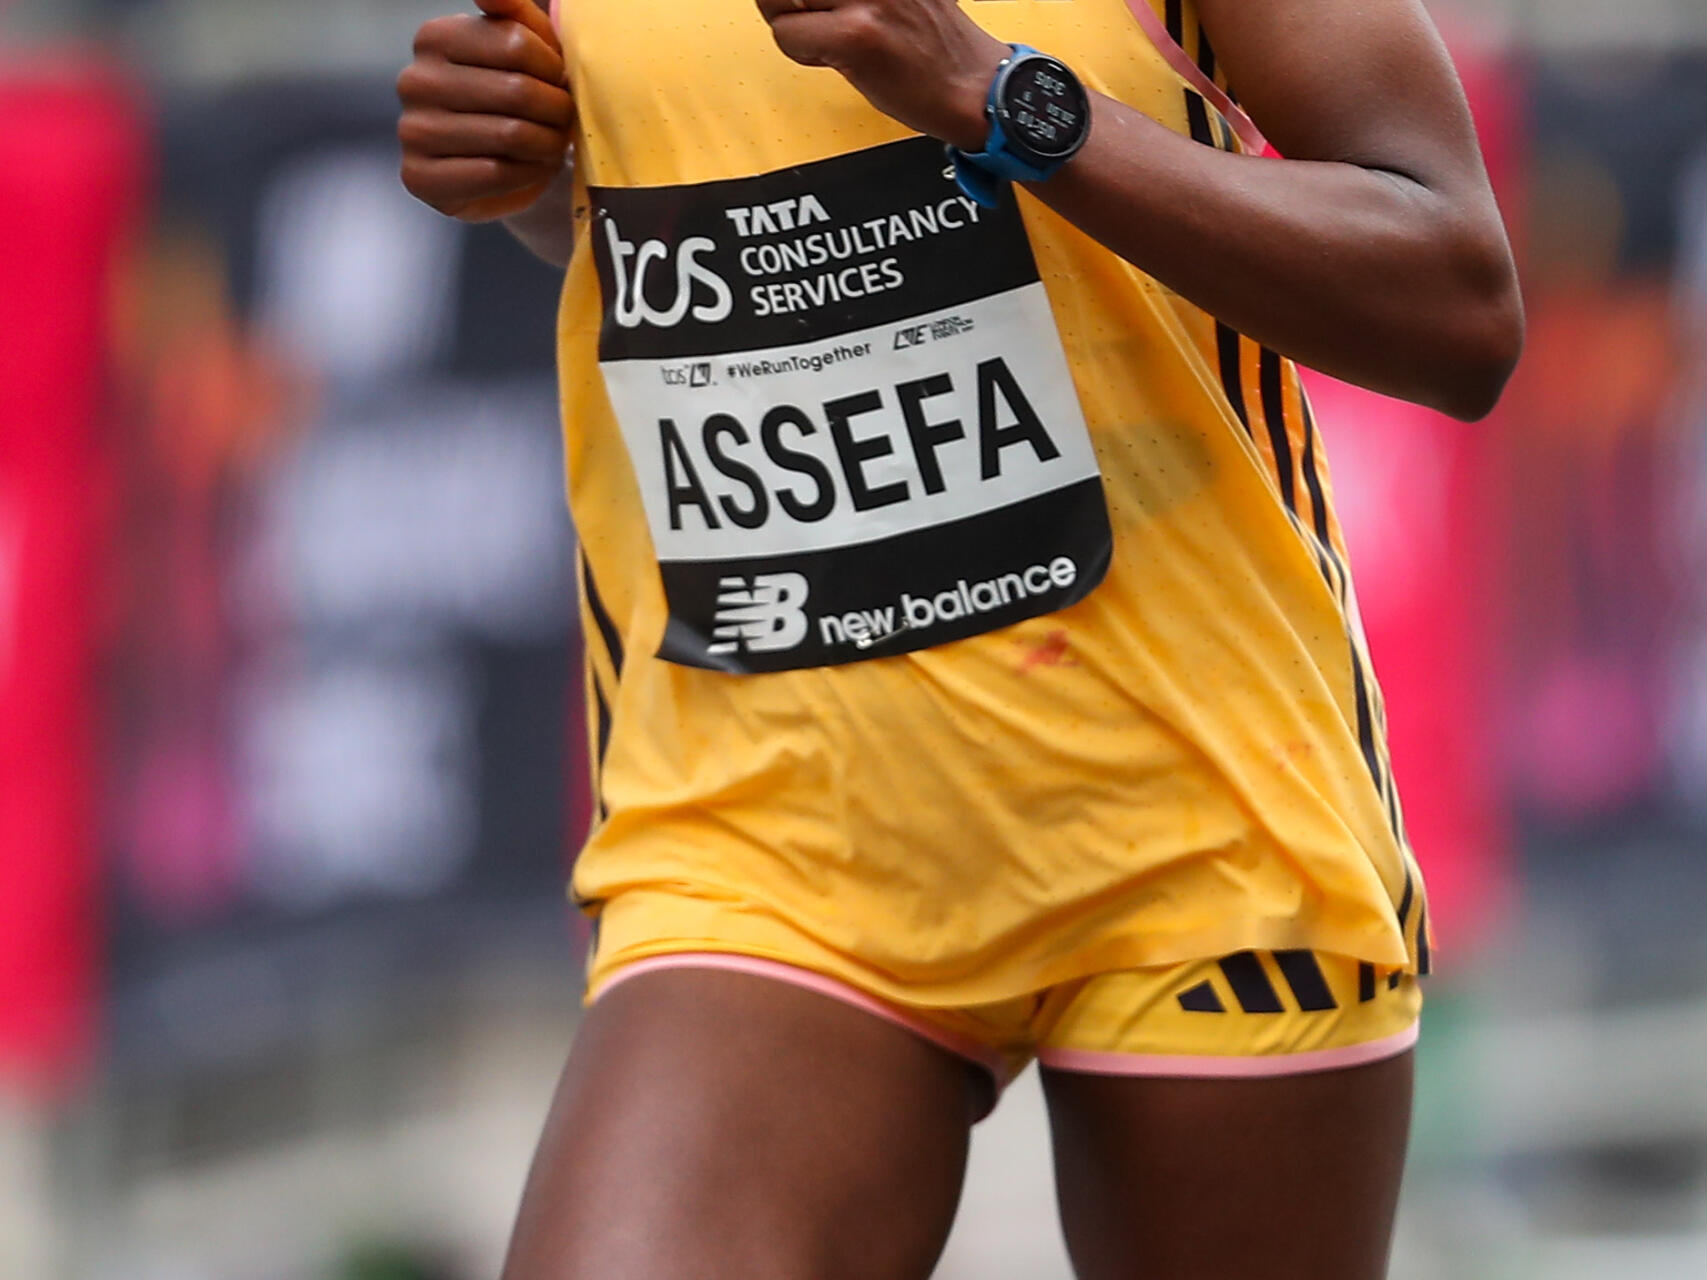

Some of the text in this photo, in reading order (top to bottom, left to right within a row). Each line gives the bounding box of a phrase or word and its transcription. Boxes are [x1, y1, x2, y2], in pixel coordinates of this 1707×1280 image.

[725, 194, 831, 237] TATA
[740, 195, 981, 276] CONSULTANCY
[605, 218, 733, 328] tcs
[751, 258, 904, 316] SERVICES
[727, 341, 872, 379] #WeRunTogether
[657, 355, 1062, 531] ASSEFA
[819, 556, 1077, 646] new balance
